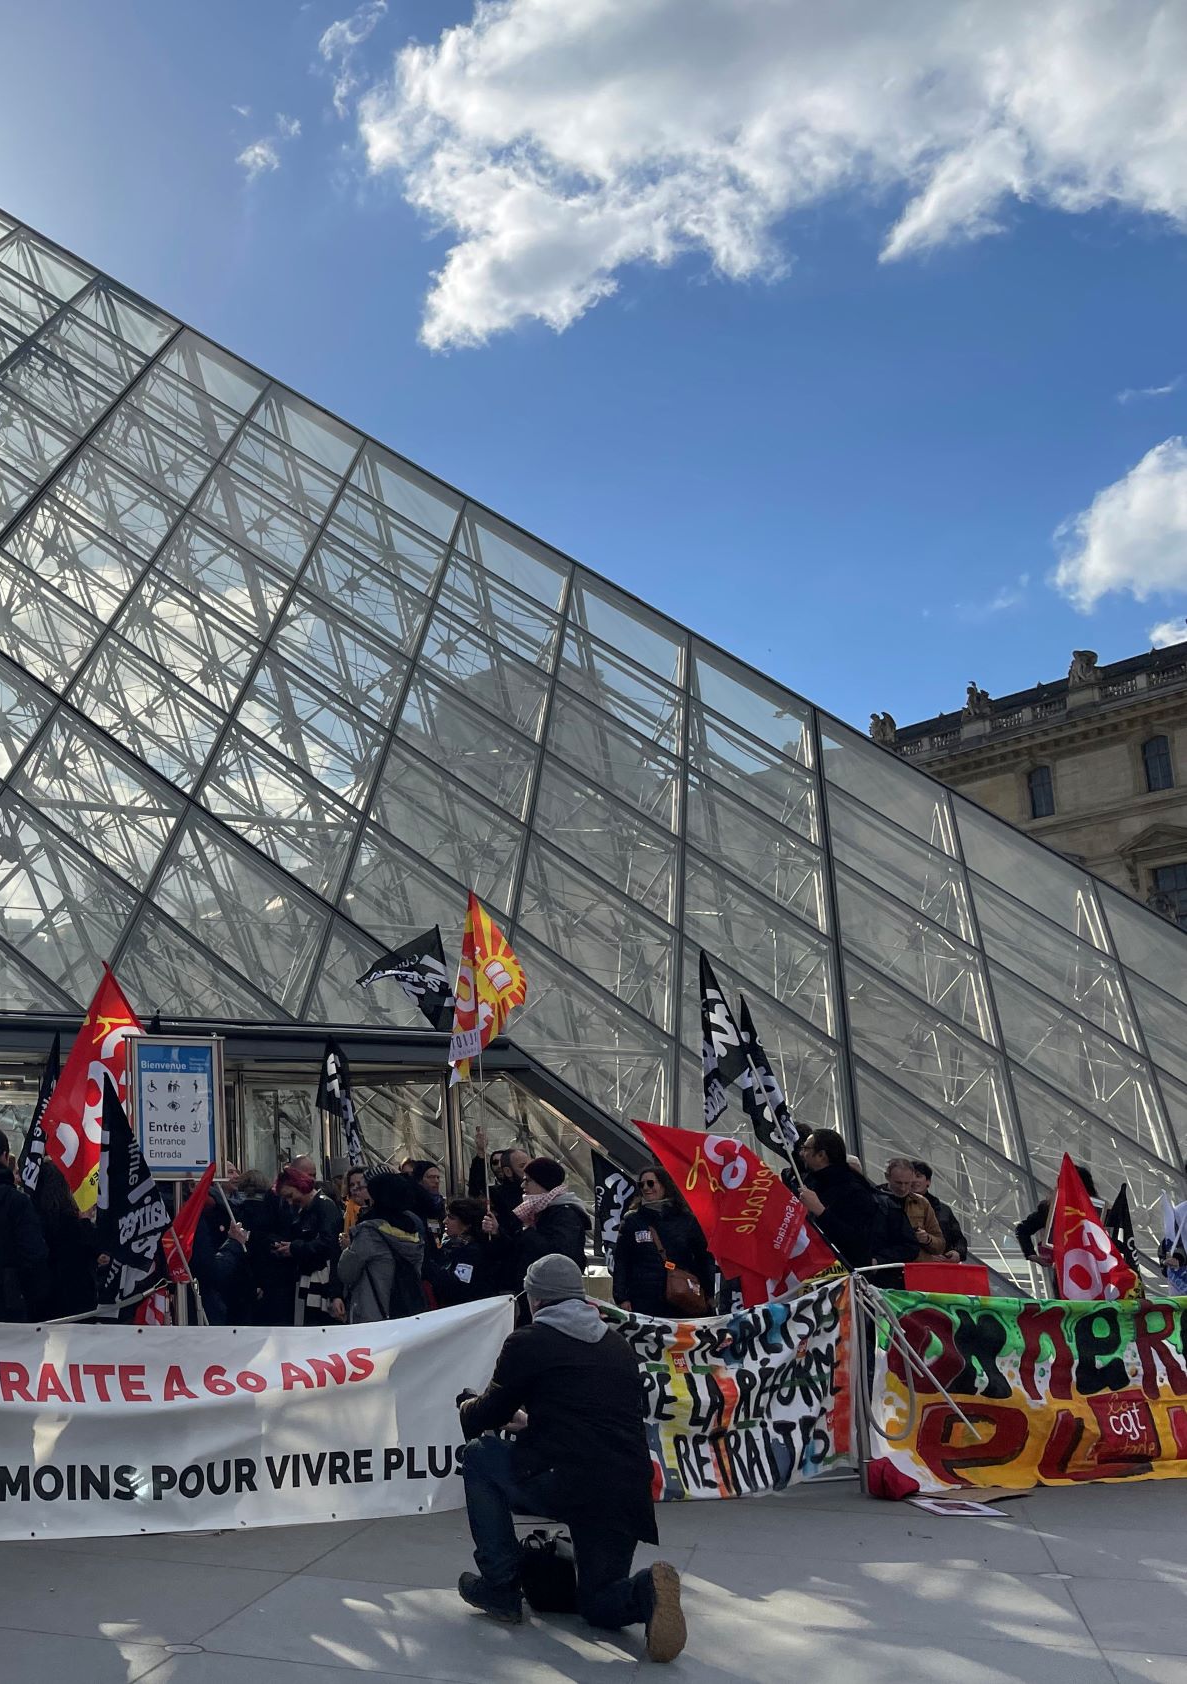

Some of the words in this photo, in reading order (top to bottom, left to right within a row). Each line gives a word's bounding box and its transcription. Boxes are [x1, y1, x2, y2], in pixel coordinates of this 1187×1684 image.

[141, 1060, 187, 1070] Bienvenue
[149, 1121, 186, 1132] Entrée
[149, 1137, 186, 1146] Entrance
[149, 1150, 182, 1159] Entrada
[164, 1365, 199, 1401] A
[203, 1365, 267, 1396] 60
[281, 1348, 375, 1391] ANS
[1109, 1402, 1146, 1440] cgt
[152, 1458, 258, 1500] POUR
[265, 1449, 373, 1489] VIVRE
